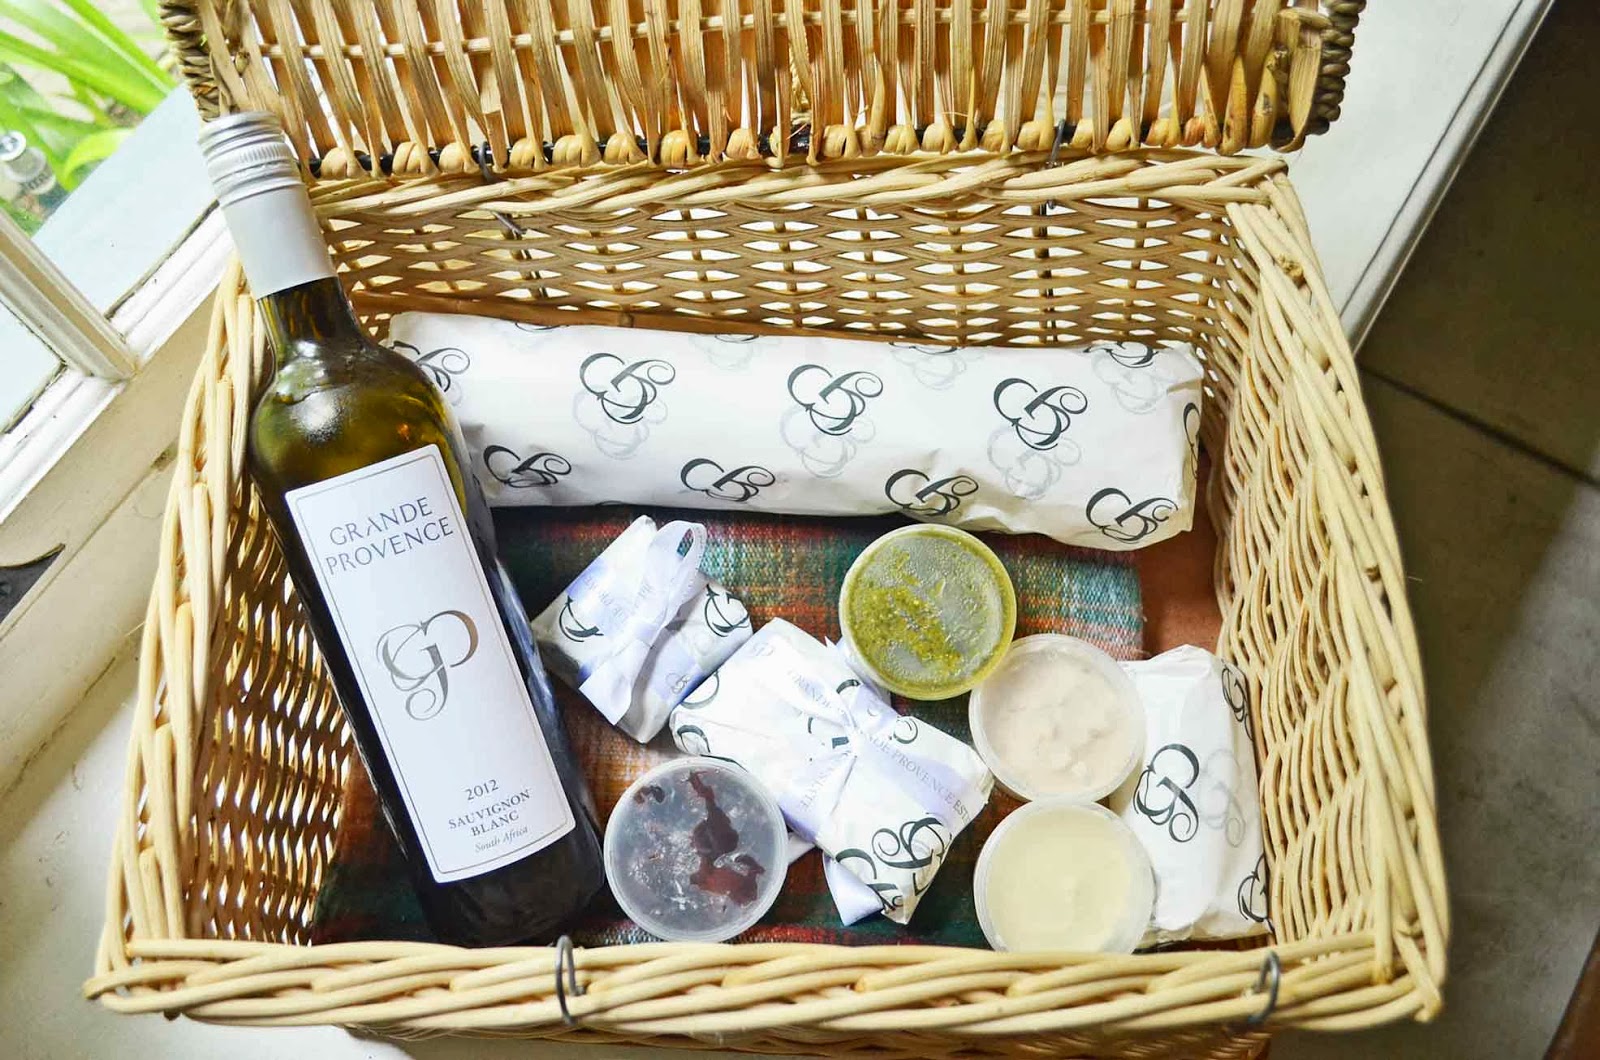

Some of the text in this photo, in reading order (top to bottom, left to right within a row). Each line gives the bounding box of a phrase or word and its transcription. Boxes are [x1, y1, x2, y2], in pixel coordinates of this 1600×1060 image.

[329, 496, 433, 546] GRANDE
[325, 516, 454, 576] PROVENCE
[464, 779, 499, 801] 2012
[447, 788, 531, 830] SAUVIGNON
[470, 809, 520, 837] BLANC
[474, 824, 529, 854] South Africa
